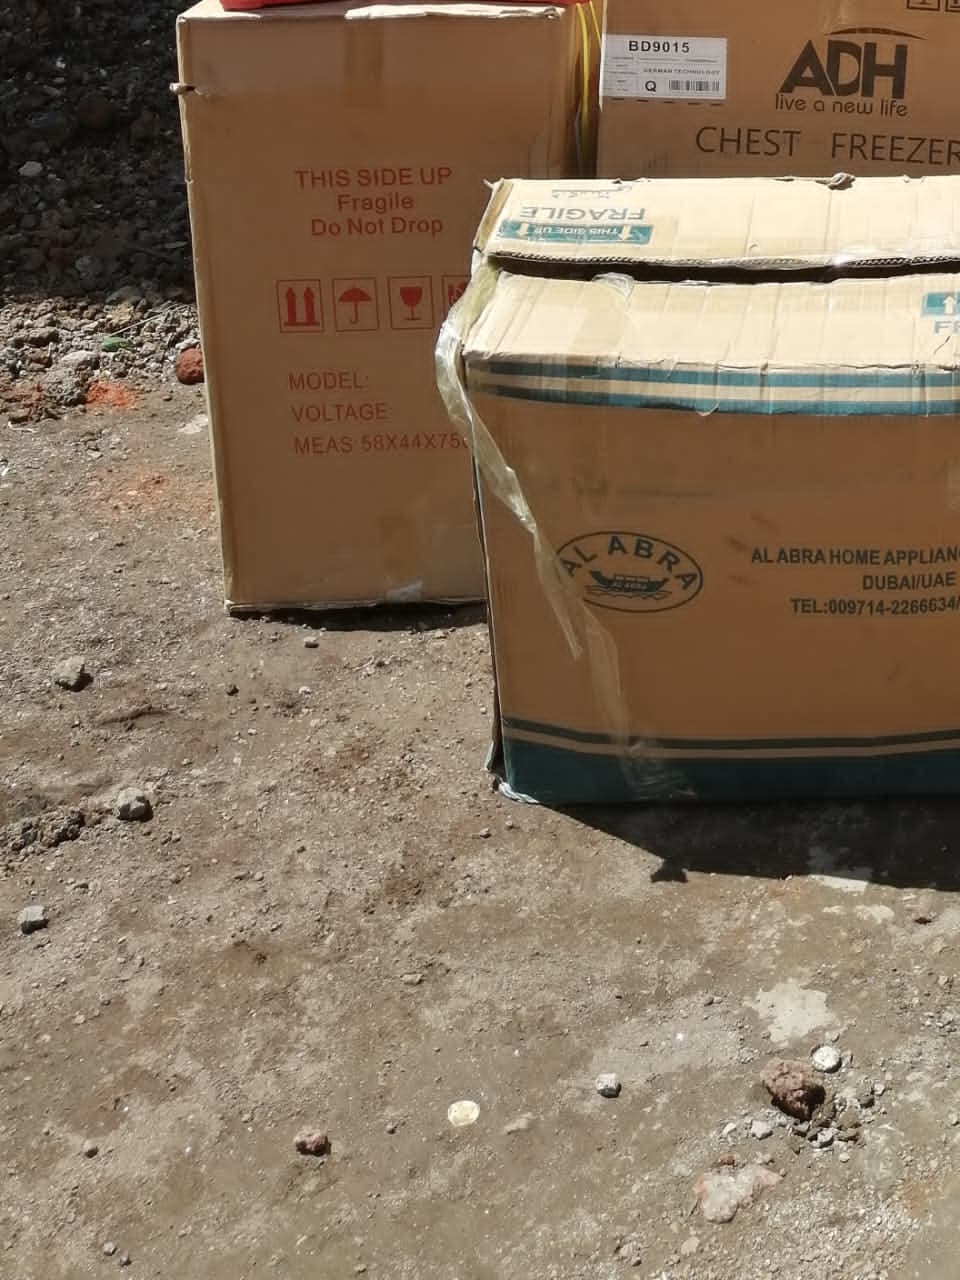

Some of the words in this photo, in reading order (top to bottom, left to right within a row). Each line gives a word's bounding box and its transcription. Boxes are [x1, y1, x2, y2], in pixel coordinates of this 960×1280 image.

[628, 40, 690, 53] BD9015
[778, 39, 908, 99] ADH
[645, 80, 657, 93] Q
[775, 93, 807, 111] live
[813, 99, 825, 112] a
[832, 100, 874, 115] new
[880, 98, 909, 118] life
[695, 125, 802, 158] CHEST
[295, 169, 350, 191] THIS
[357, 168, 414, 188] SIDE
[420, 167, 452, 187] UP
[337, 192, 414, 214] Fragile
[519, 205, 646, 221] FRAGILE
[311, 219, 341, 237] Do
[347, 218, 385, 236] Not
[391, 217, 443, 238] Drop
[559, 545, 599, 578] AL
[607, 535, 699, 590] ABRA
[751, 547, 775, 564] AL
[776, 547, 826, 565] ABRA
[829, 548, 881, 566] HOME
[862, 571, 957, 591] DUBAI/UAE
